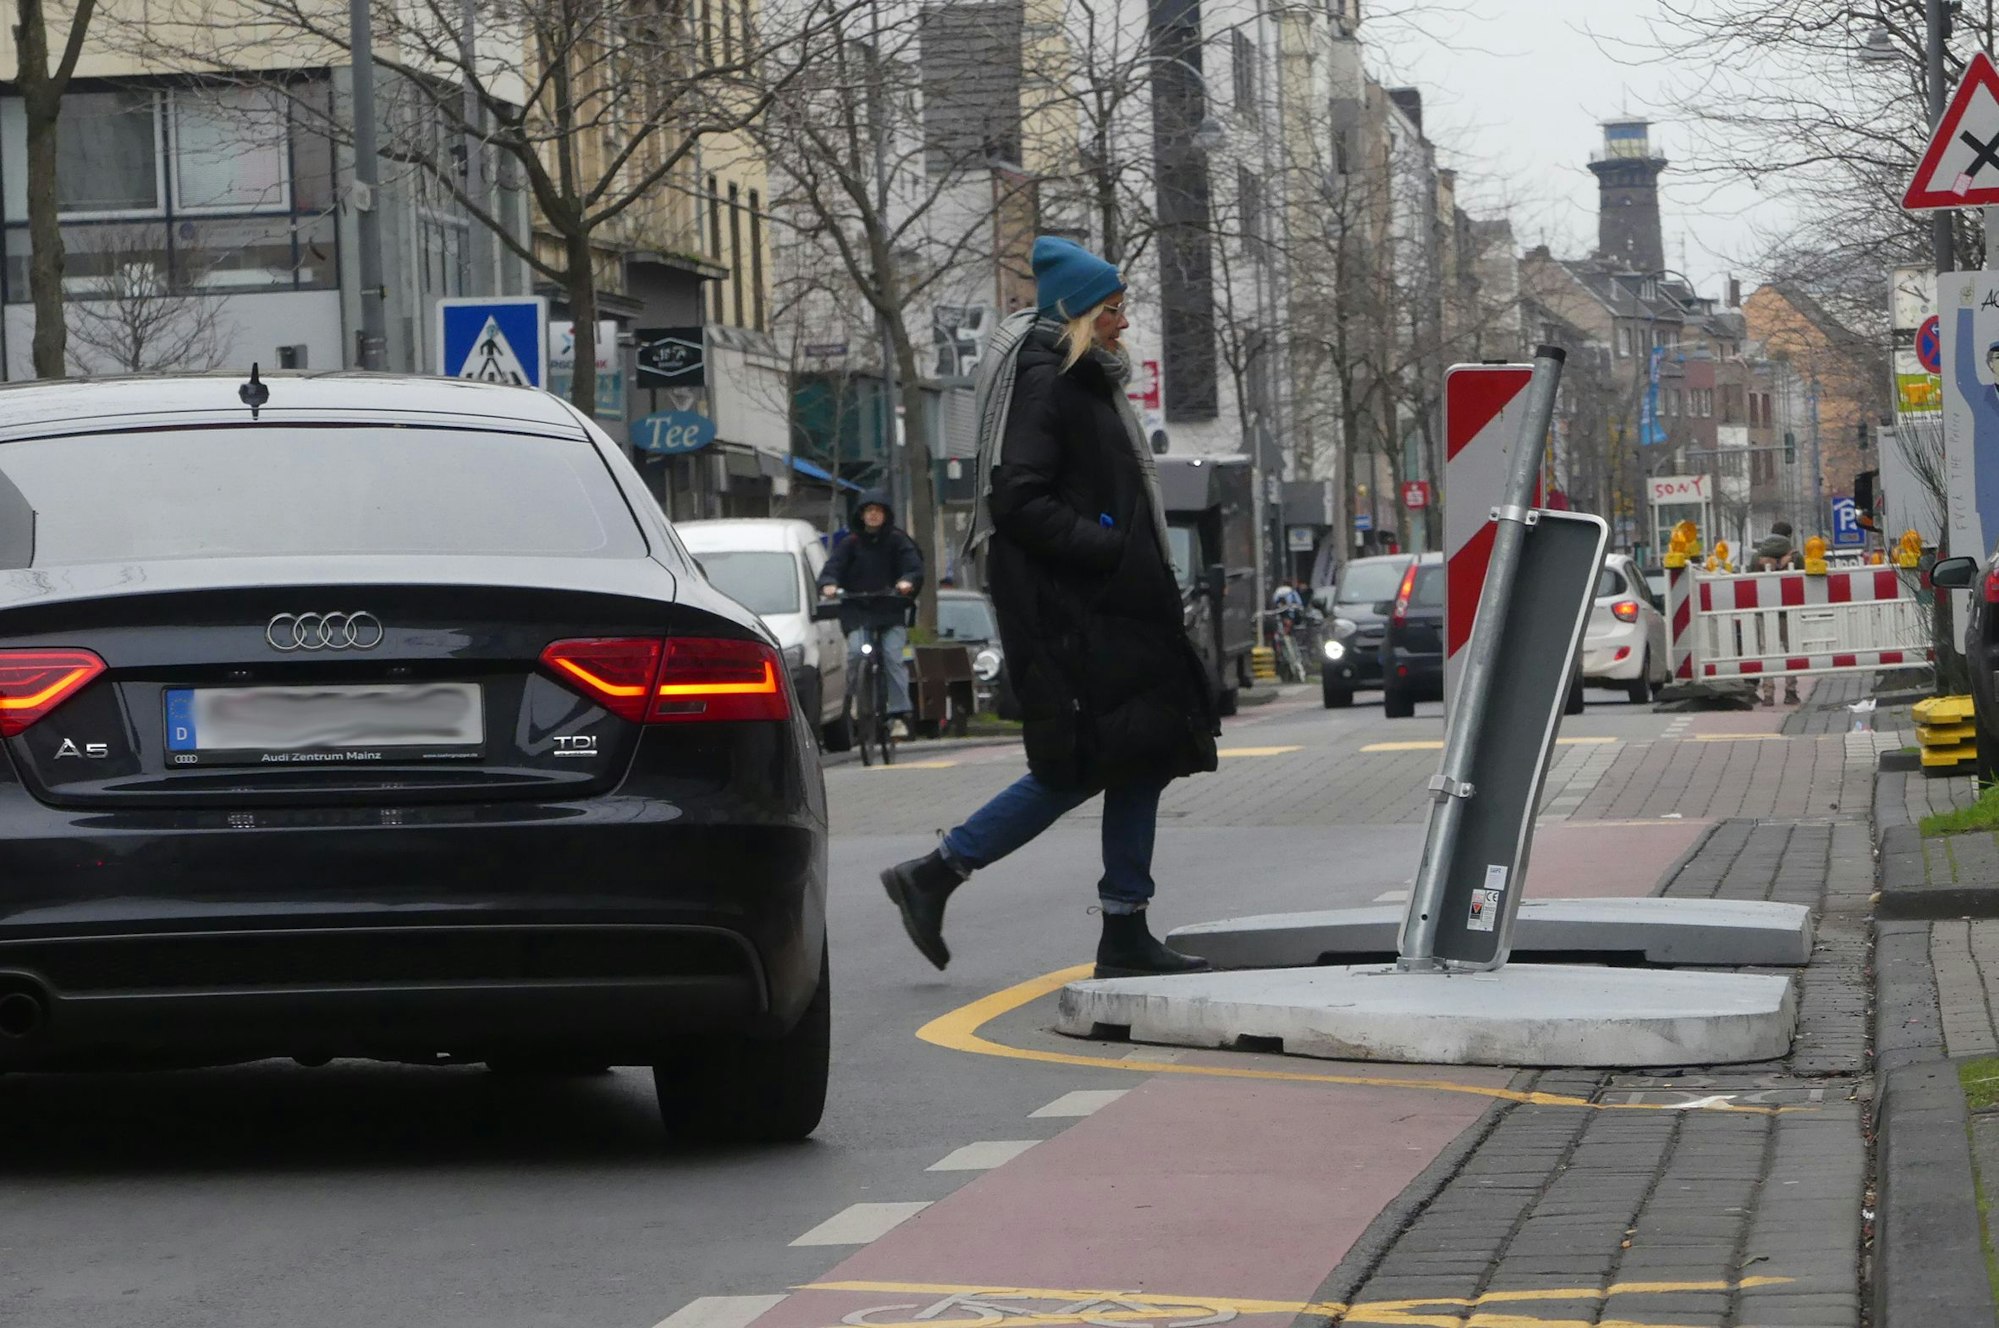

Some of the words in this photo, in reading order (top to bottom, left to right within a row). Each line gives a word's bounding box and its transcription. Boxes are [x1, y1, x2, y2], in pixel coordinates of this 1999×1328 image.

[645, 416, 700, 449] Tee
[176, 727, 188, 740] D
[53, 737, 108, 760] A5
[553, 735, 597, 749] TDI
[261, 752, 289, 762] Audi
[291, 752, 344, 762] Zentrum
[346, 751, 382, 760] Mainz
